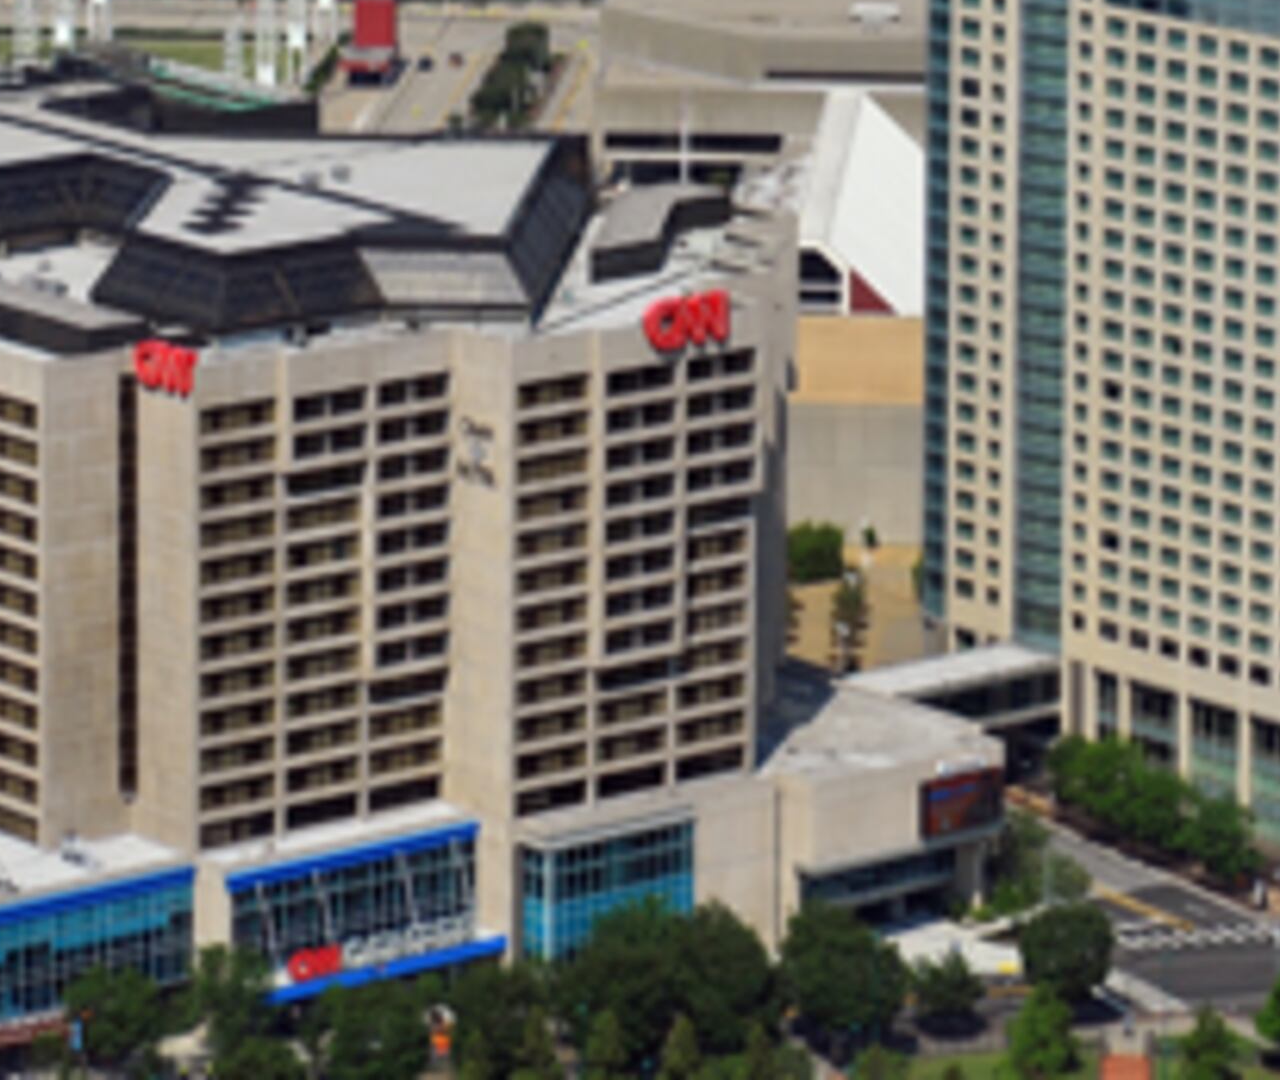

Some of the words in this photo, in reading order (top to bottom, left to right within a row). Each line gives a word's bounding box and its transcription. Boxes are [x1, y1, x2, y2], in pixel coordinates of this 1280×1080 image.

[642, 290, 731, 351] CNN
[133, 338, 198, 398] CNN
[287, 942, 342, 982] CNN
